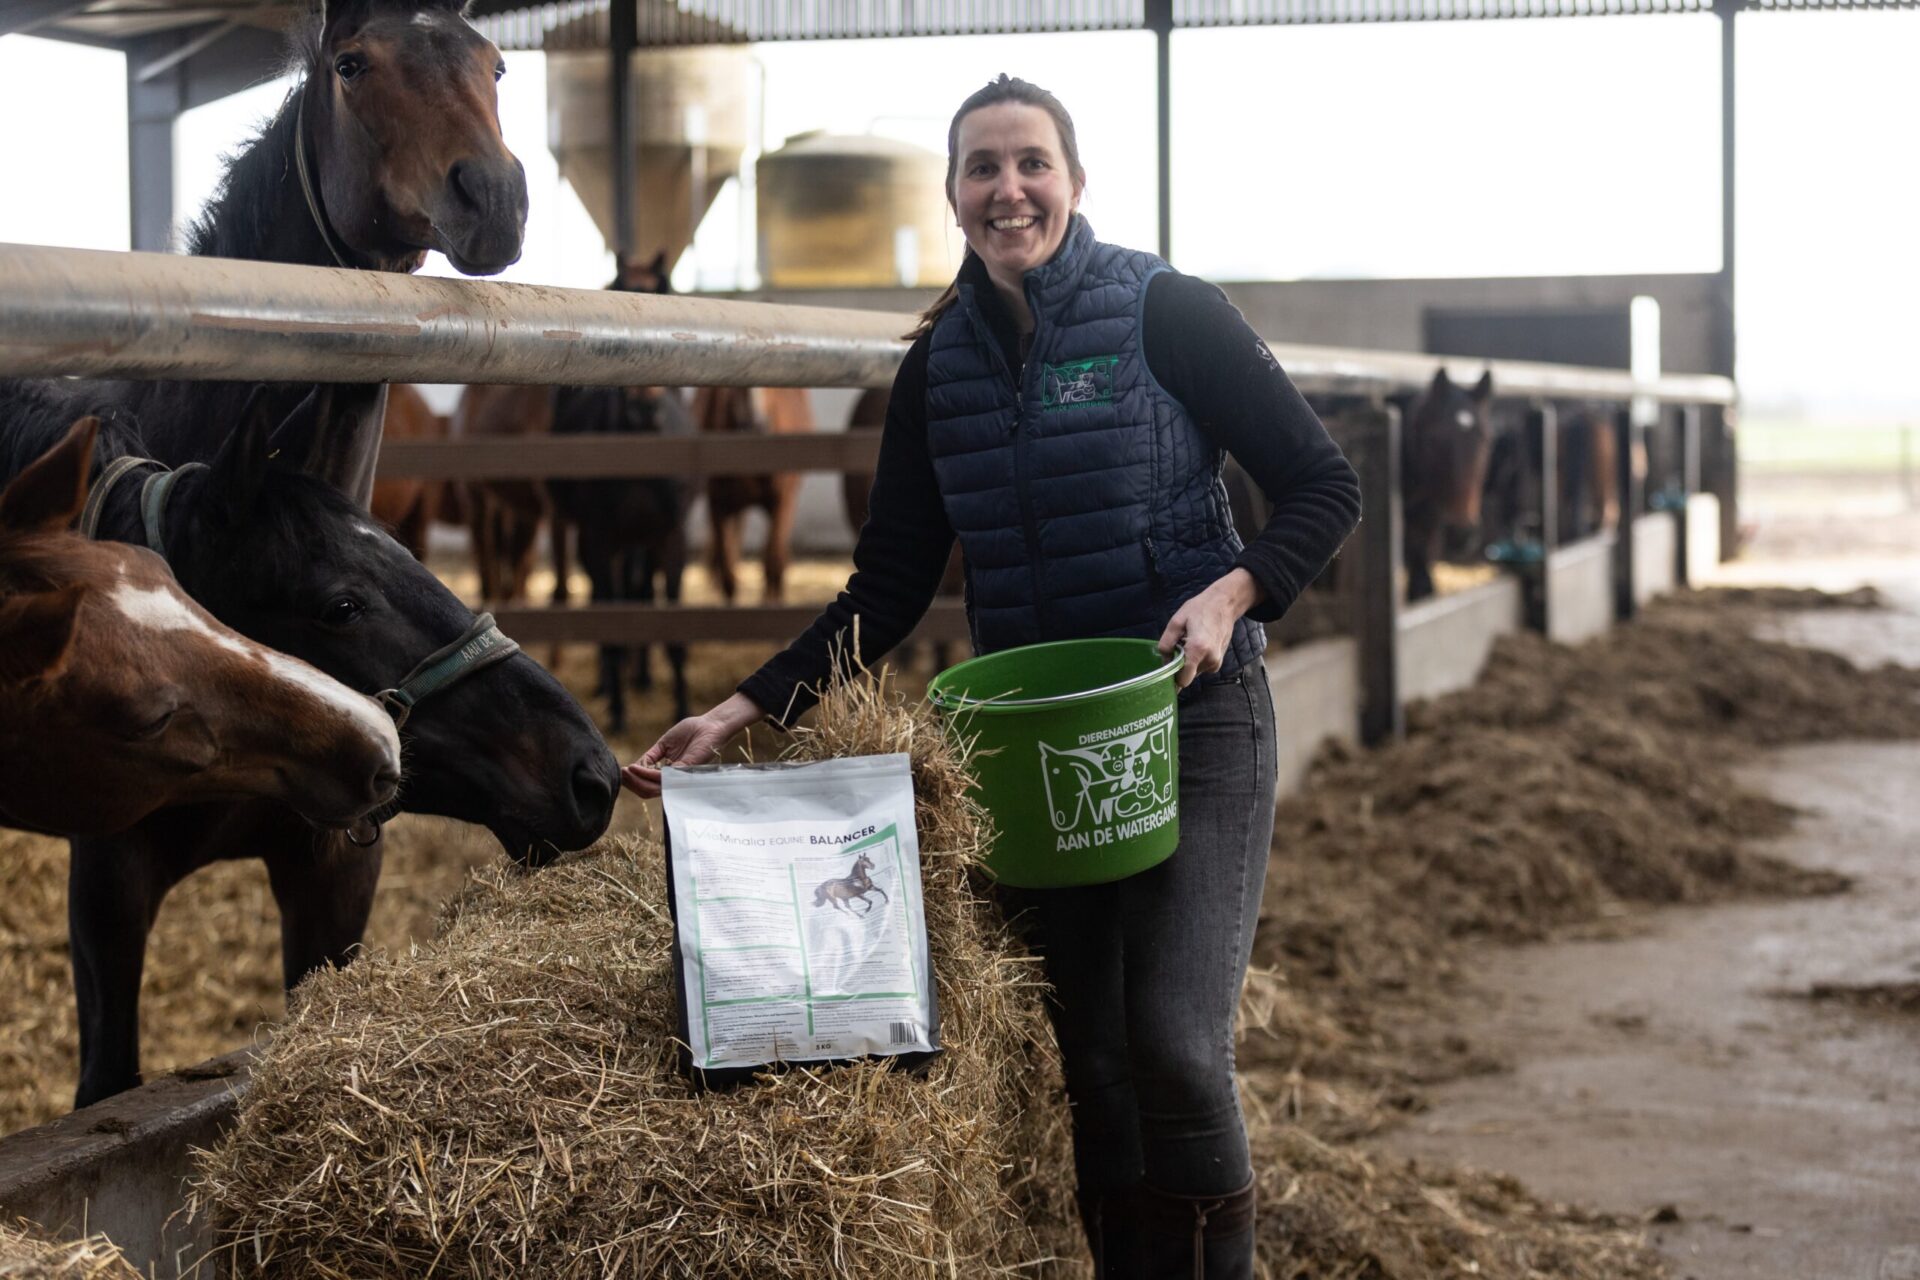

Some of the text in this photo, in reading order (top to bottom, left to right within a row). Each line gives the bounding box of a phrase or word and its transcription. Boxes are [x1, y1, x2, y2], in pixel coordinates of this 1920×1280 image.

[460, 642, 483, 662] AAN
[1078, 703, 1174, 745] DIERENARTSENPRAKTIJK
[769, 835, 805, 846] EQUINE
[809, 825, 876, 845] BALANCER
[1056, 801, 1177, 852] AAN DE WATERGANG
